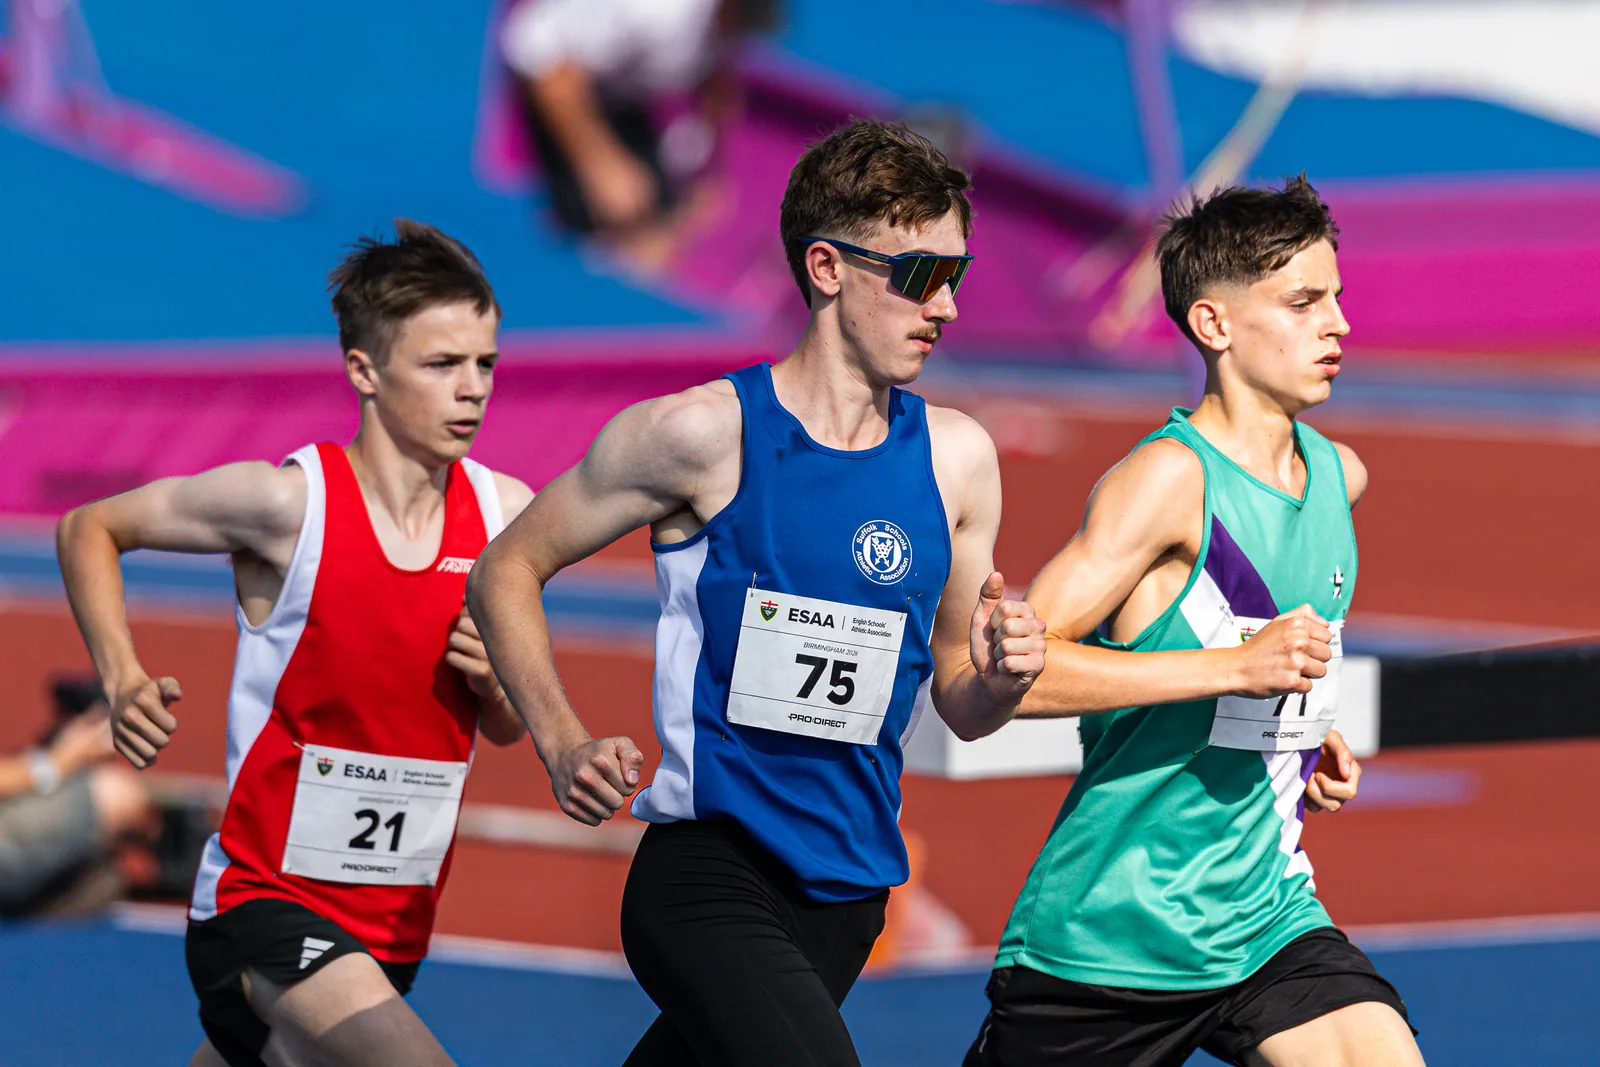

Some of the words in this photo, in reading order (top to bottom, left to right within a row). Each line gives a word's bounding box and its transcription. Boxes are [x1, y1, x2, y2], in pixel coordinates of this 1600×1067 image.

[856, 524, 877, 544] Suffolk
[885, 524, 907, 551] Schools
[856, 551, 873, 576] Athletic
[879, 557, 909, 580] Association
[788, 607, 835, 628] ESAA
[852, 617, 868, 626] English
[851, 626, 867, 634] Athletic
[867, 628, 892, 637] Association
[803, 641, 846, 655] BIRMINGHAM
[795, 653, 858, 706] 75
[343, 763, 387, 782] ESAA
[348, 808, 407, 852] 21
